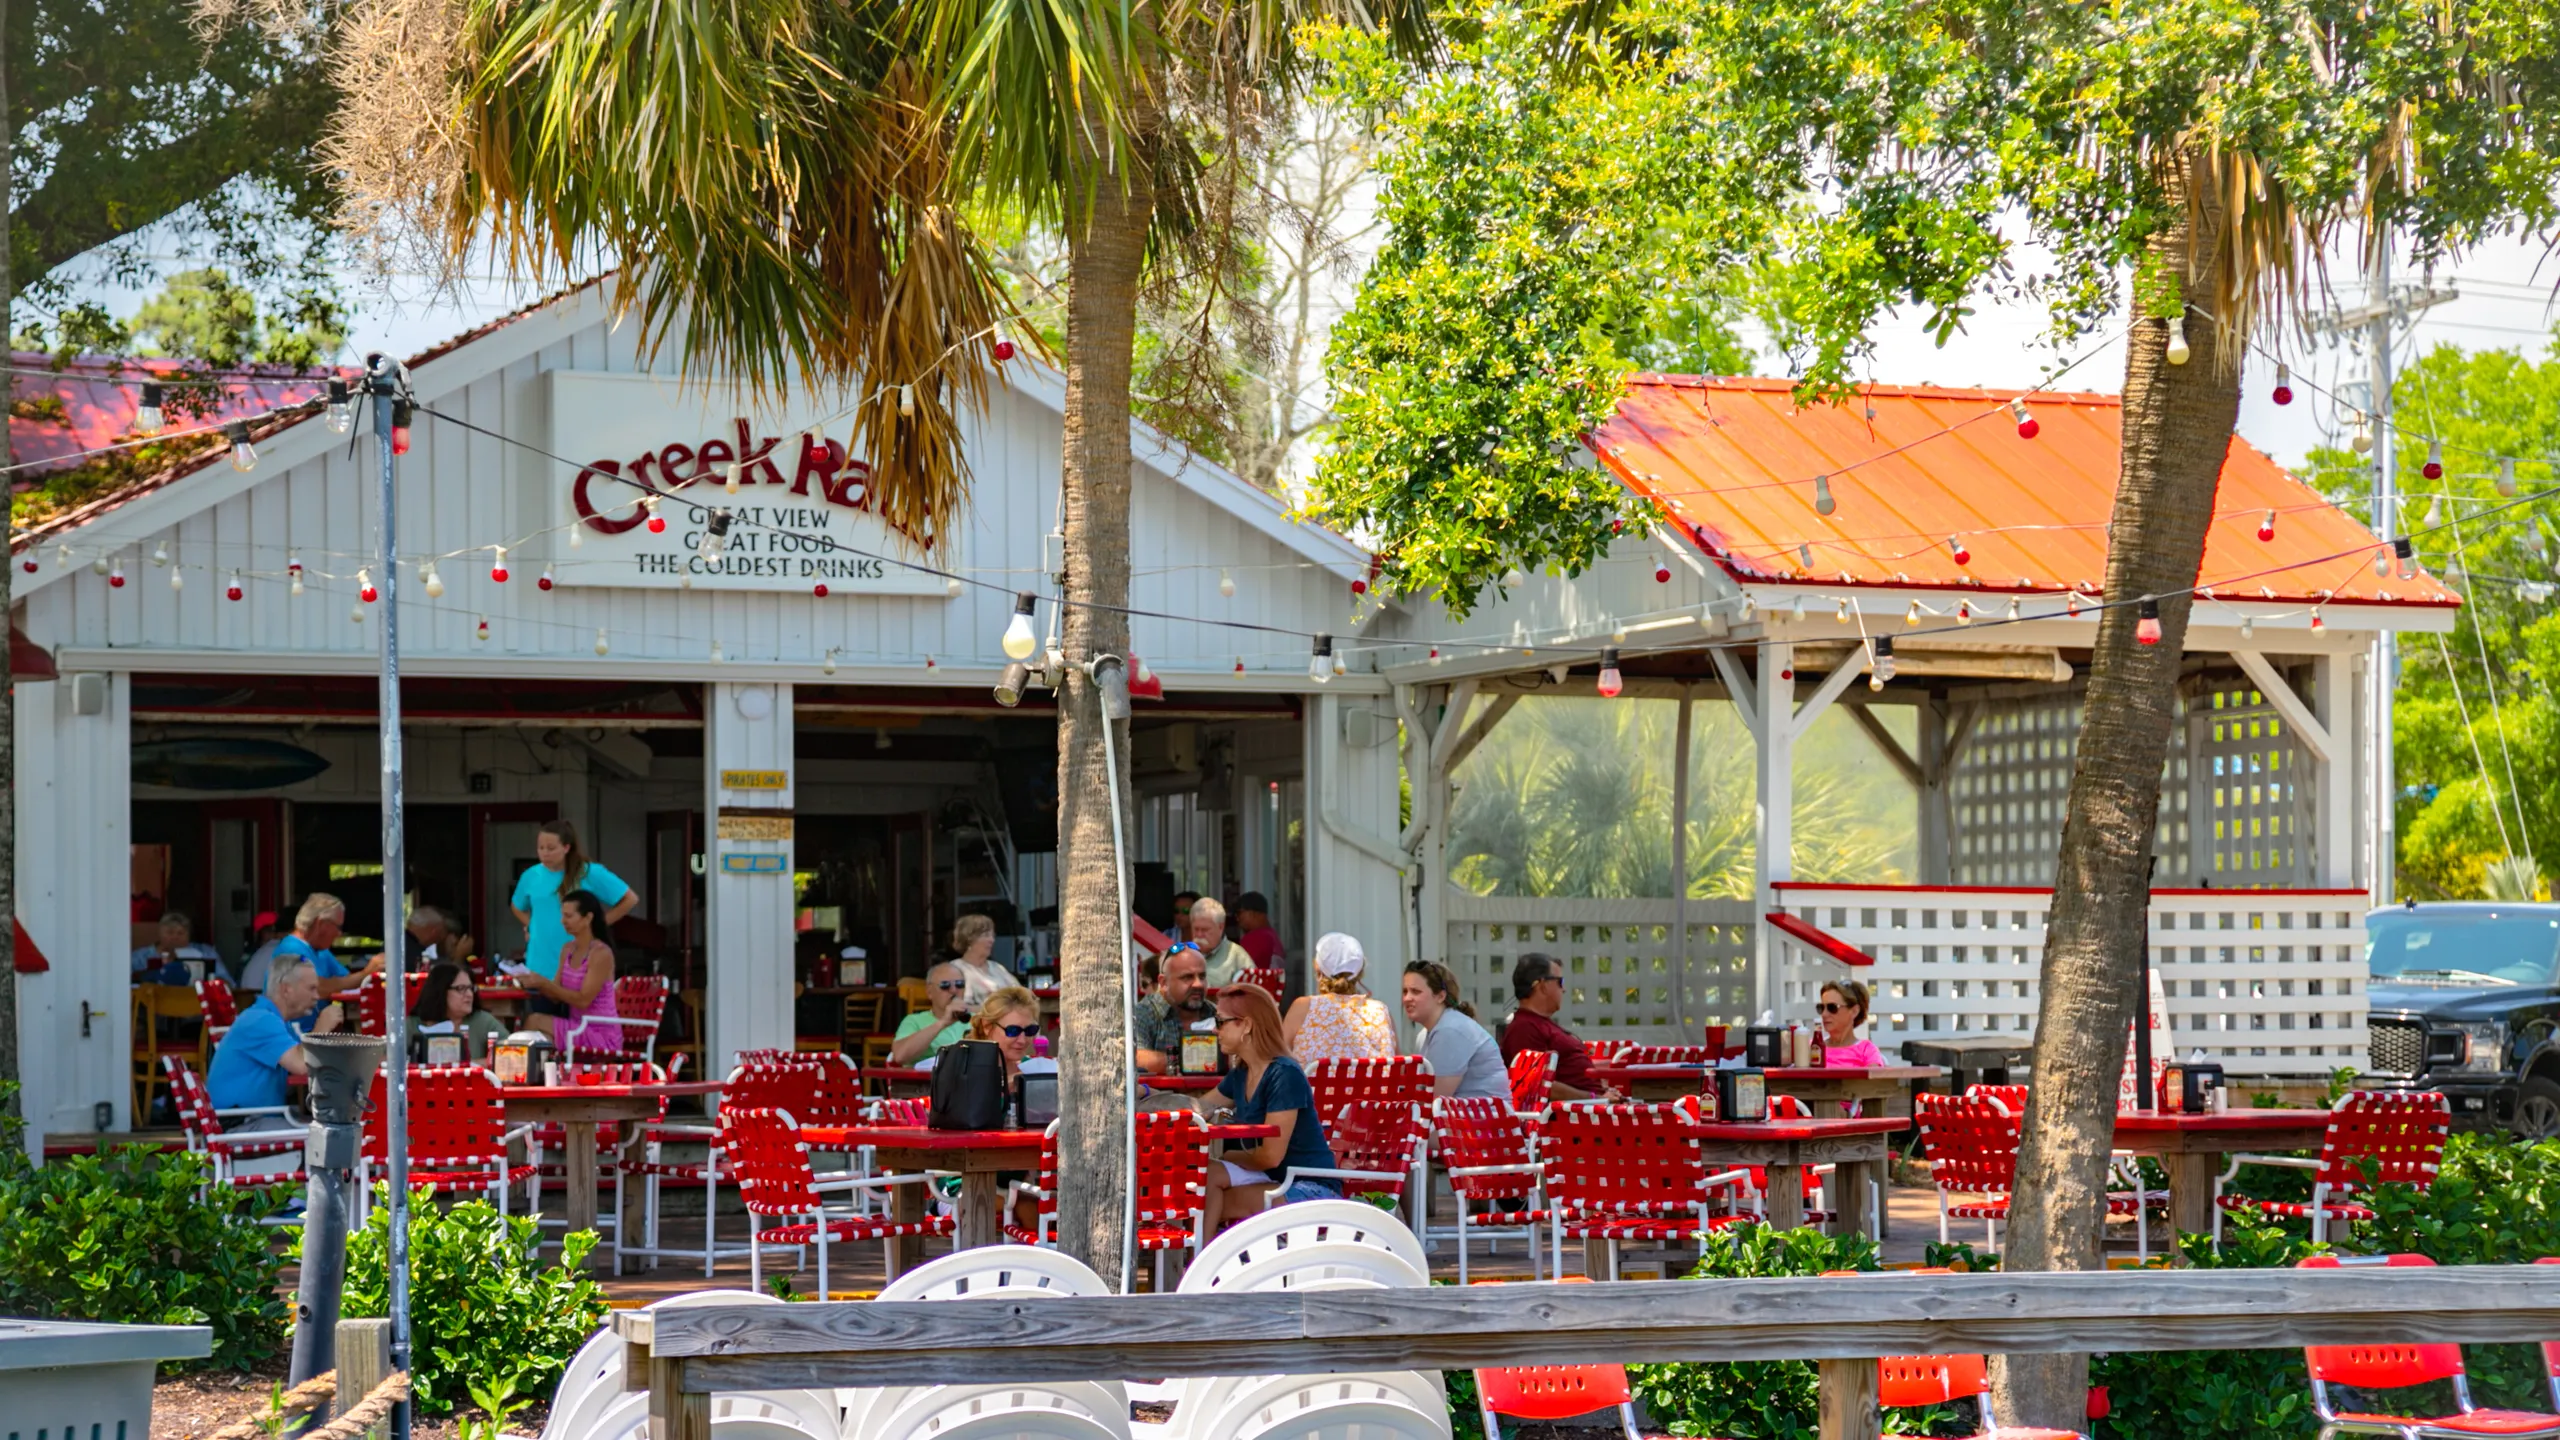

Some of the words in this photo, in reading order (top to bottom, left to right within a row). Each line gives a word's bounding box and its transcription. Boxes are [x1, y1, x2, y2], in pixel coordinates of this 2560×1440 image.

[573, 416, 785, 535] Creek
[790, 431, 935, 551] Ra
[773, 508, 830, 528] VIEW
[684, 531, 759, 551] GAT
[769, 533, 835, 553] FOOD
[635, 553, 678, 574] THE
[688, 555, 791, 577] COLDEST
[801, 558, 883, 579] DRINKS
